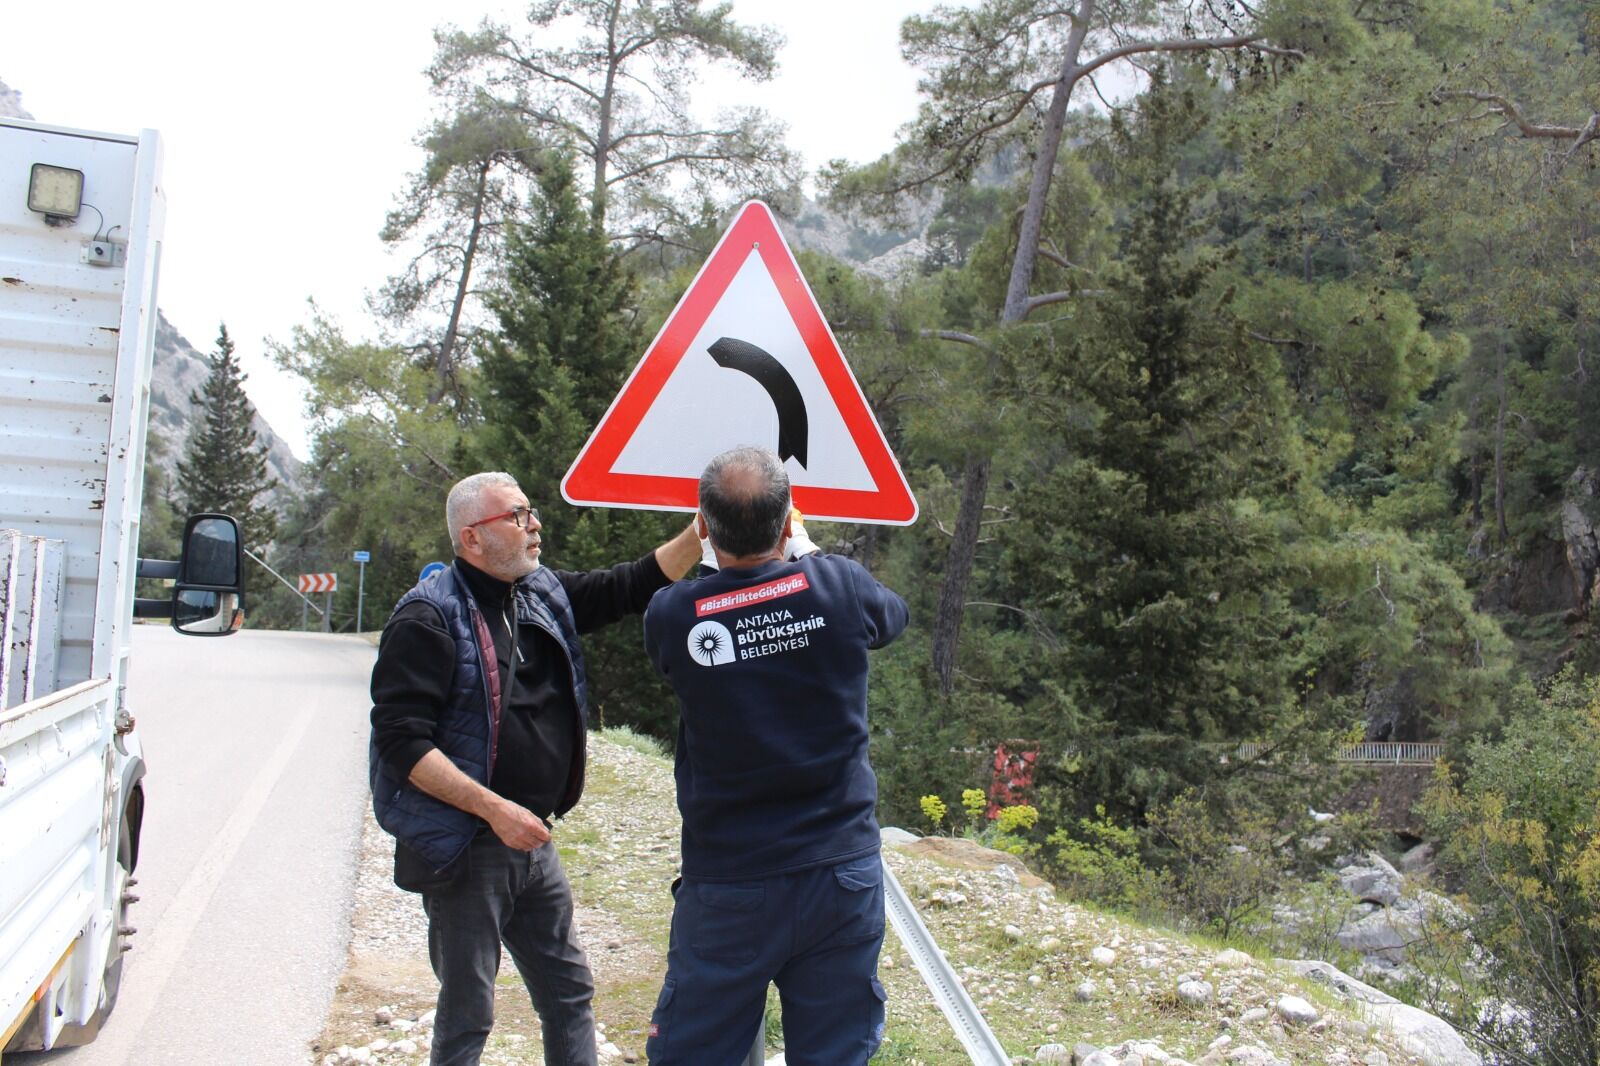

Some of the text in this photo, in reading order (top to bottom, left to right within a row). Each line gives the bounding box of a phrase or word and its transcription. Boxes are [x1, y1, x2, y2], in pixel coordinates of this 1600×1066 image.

[700, 578, 804, 612] #BizBirlikteGüçlüyüz
[735, 609, 793, 630] ANTALYA
[737, 614, 826, 646] BÜYÜKŞEHİR
[740, 633, 809, 660] BELEDİYESİ
